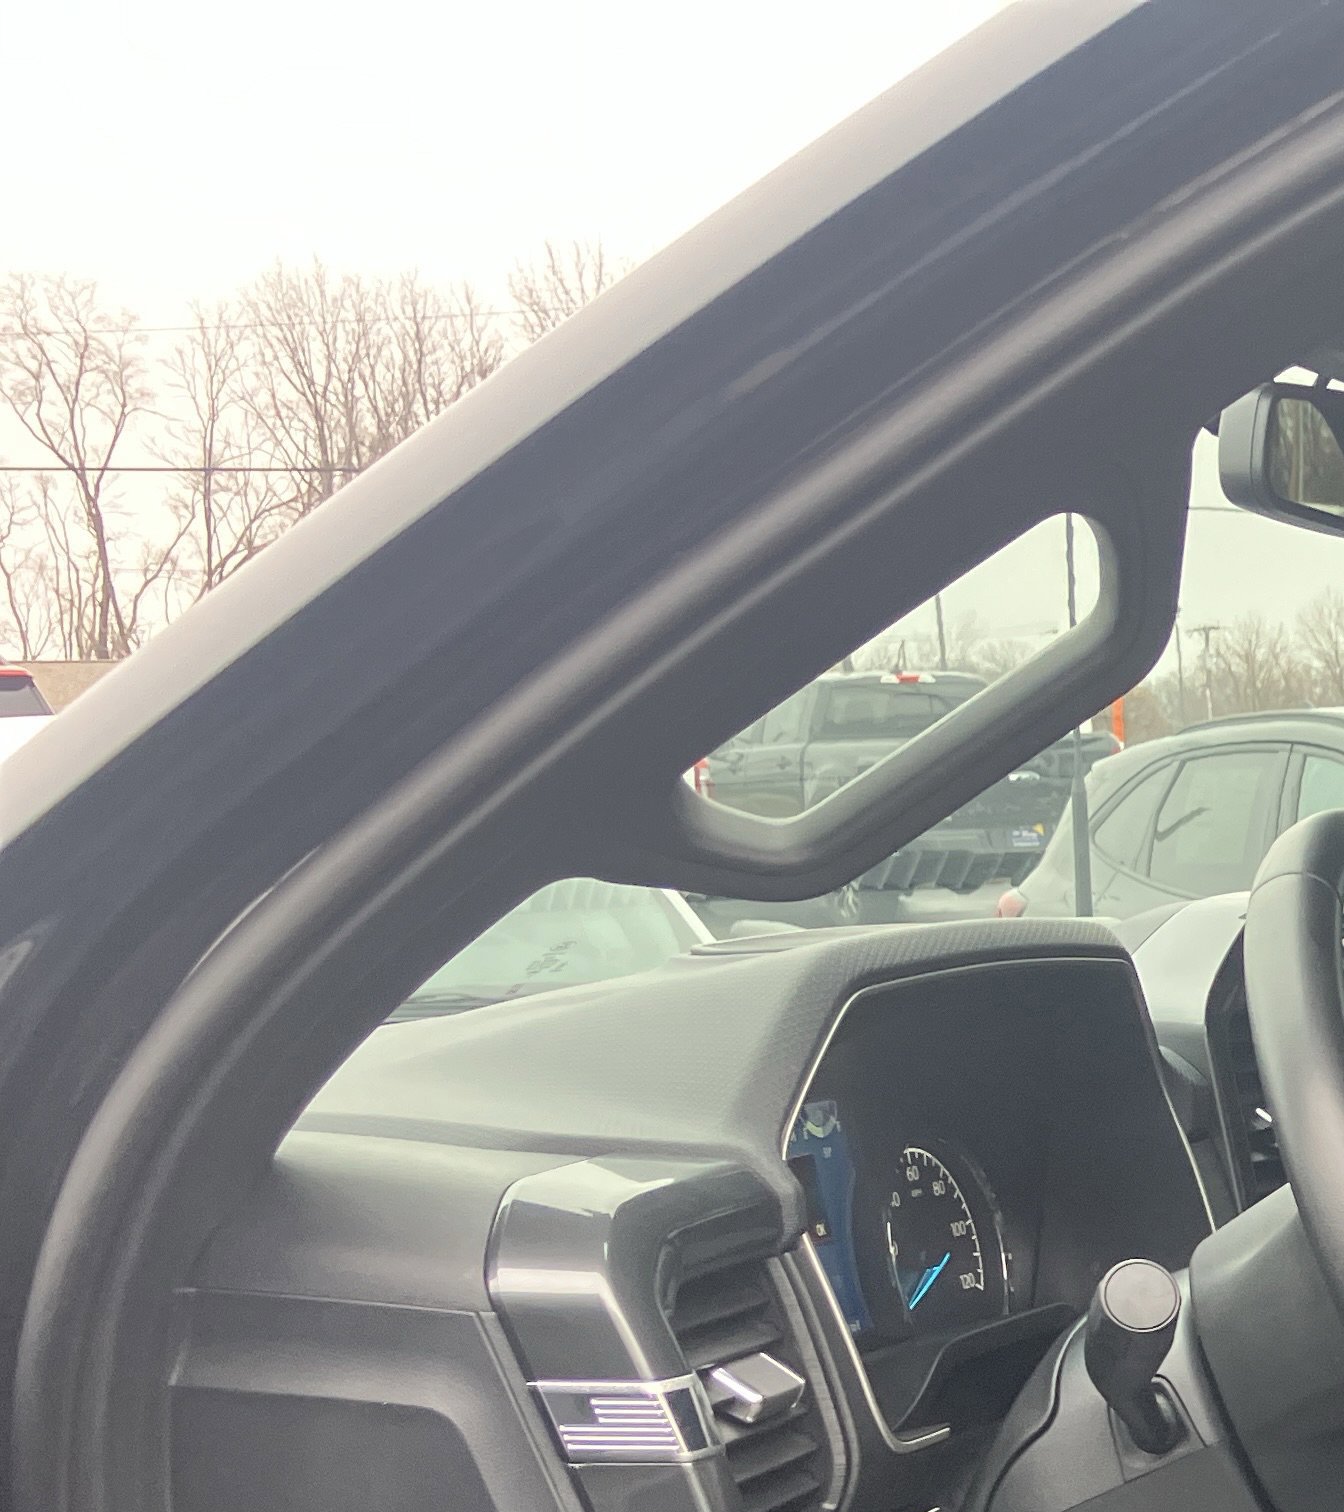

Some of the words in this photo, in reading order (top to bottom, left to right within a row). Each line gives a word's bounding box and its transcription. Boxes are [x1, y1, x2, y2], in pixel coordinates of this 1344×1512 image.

[906, 1165, 920, 1182] 60
[932, 1180, 946, 1197] 80
[950, 1220, 967, 1237] 100
[959, 1272, 976, 1290] 120
